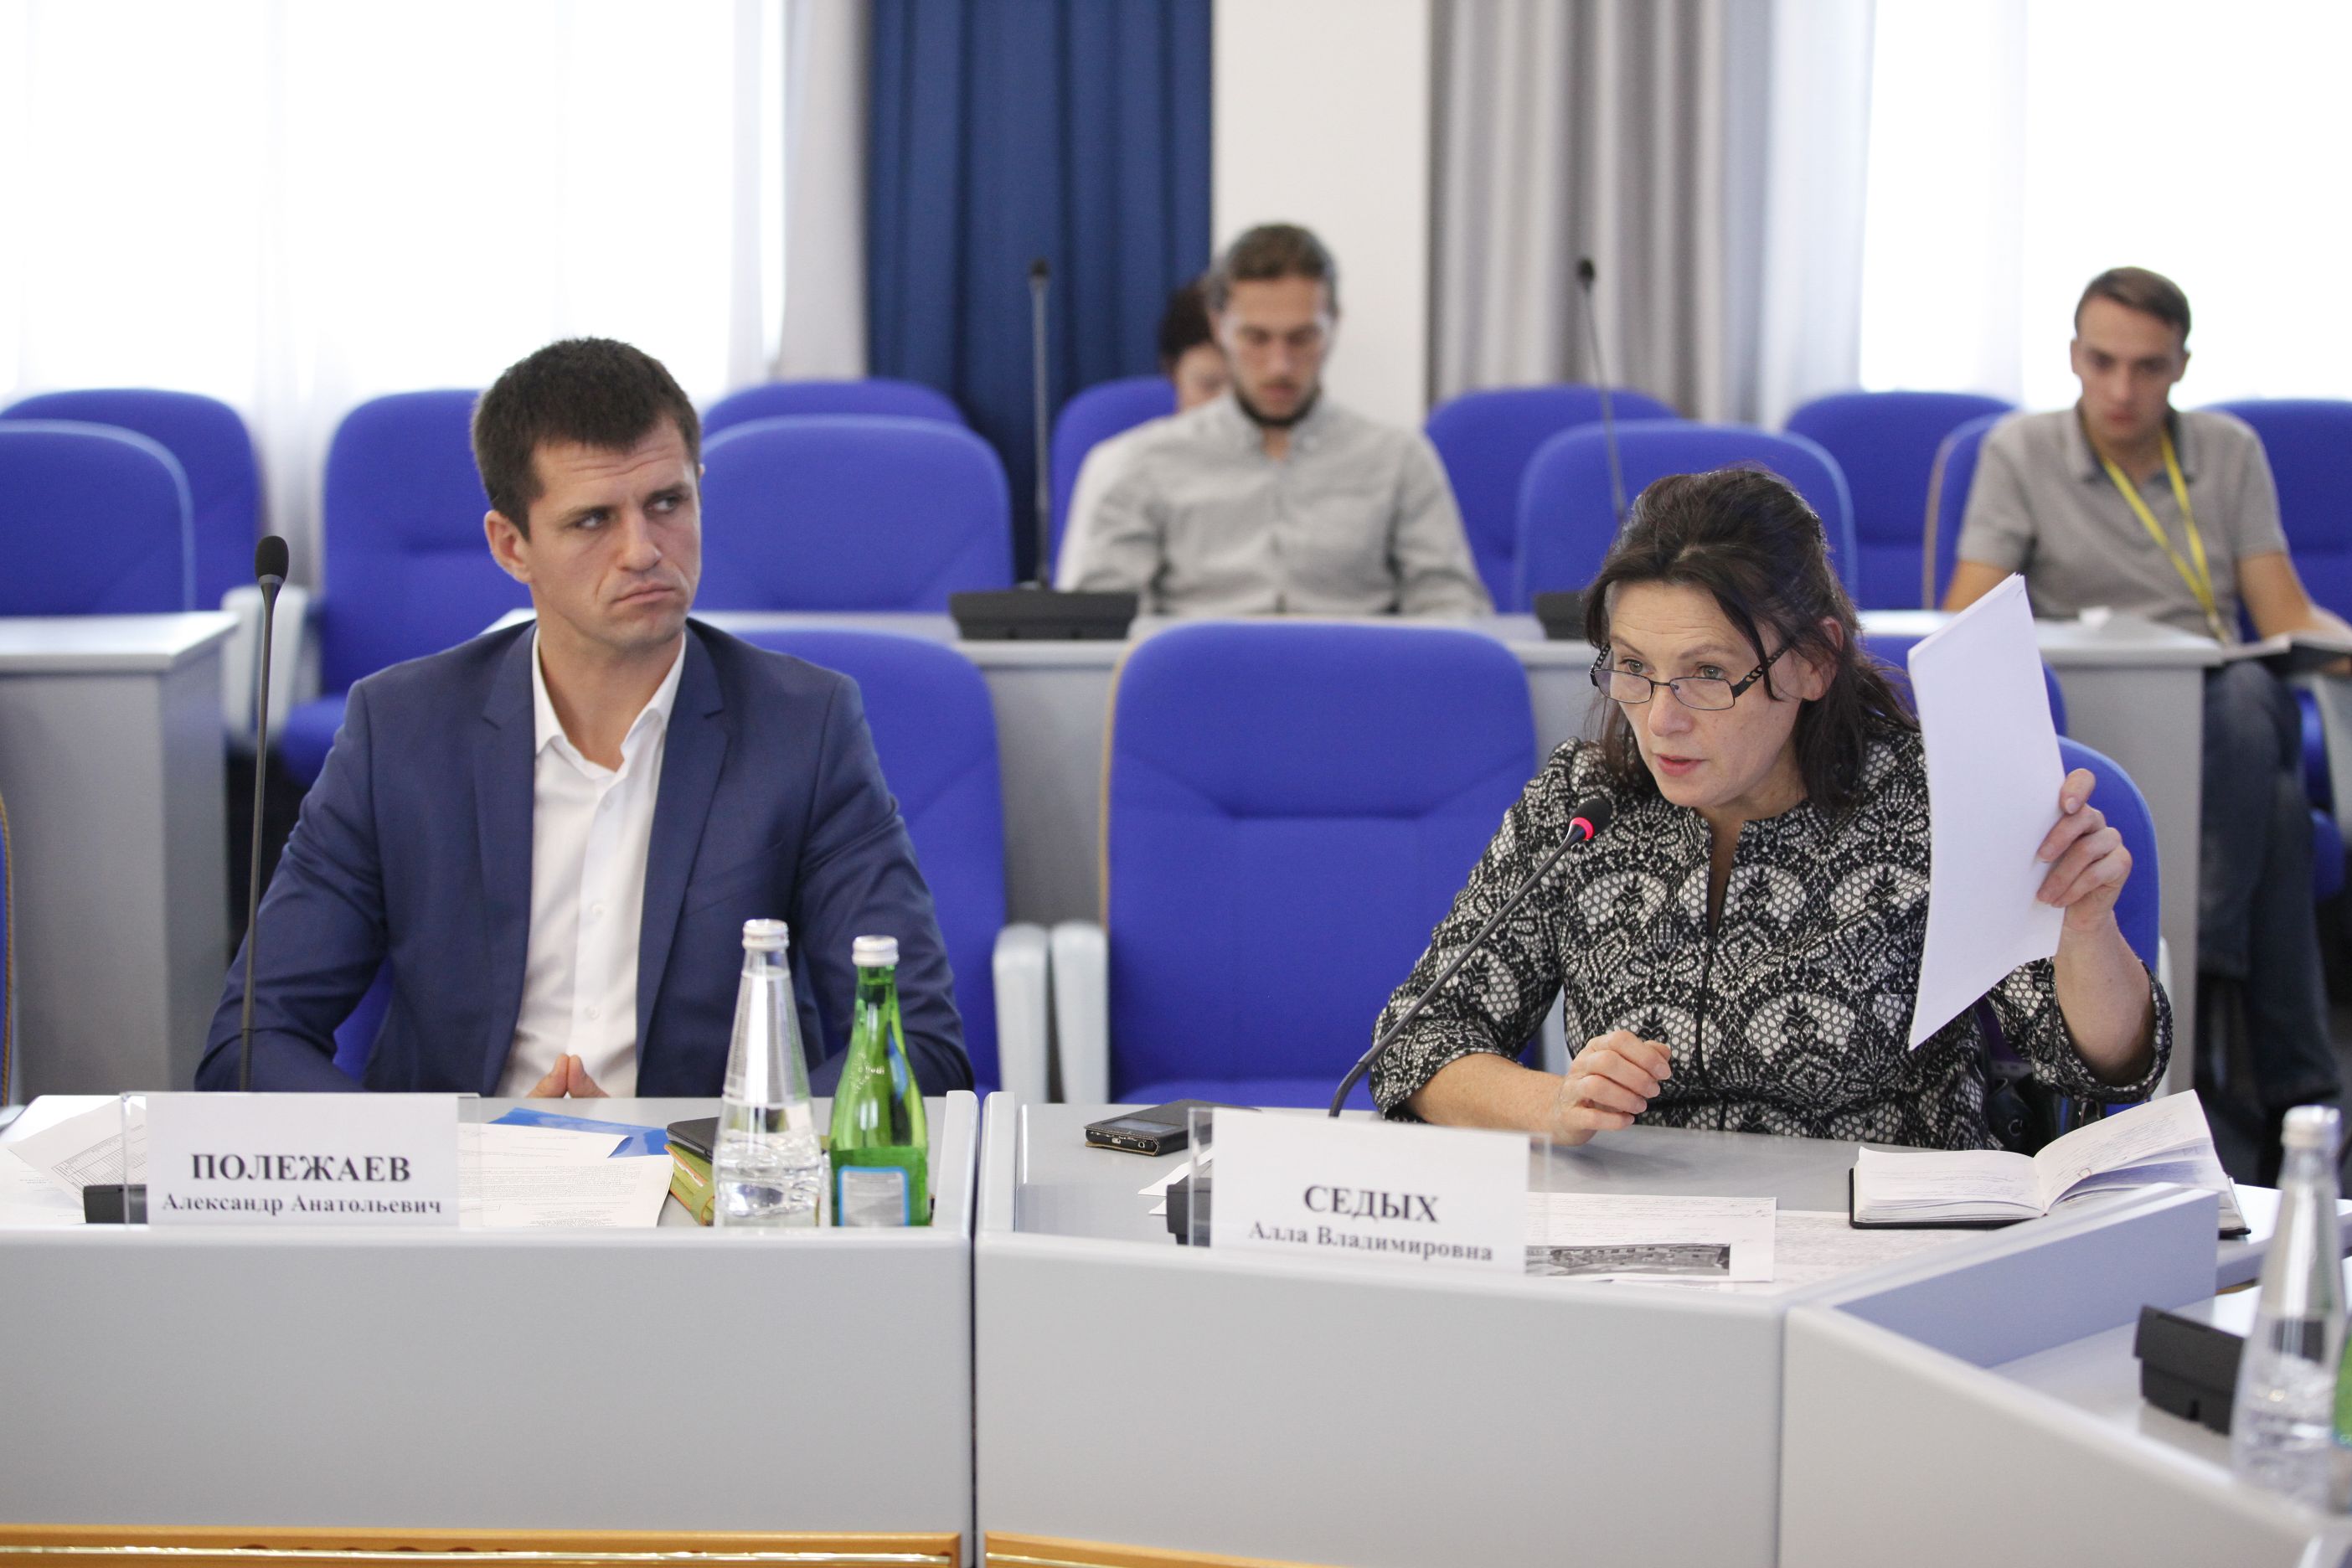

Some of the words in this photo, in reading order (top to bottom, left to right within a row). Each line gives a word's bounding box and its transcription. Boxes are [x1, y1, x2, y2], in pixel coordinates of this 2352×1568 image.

[191, 1153, 411, 1183] ПОЛЕЖАЕВ
[162, 1193, 283, 1215] Александр
[291, 1194, 442, 1214] Анатольевич
[1303, 1184, 1439, 1223] СЕДЫХ
[1249, 1220, 1308, 1244] Алла
[1317, 1225, 1493, 1261] Владимировна
